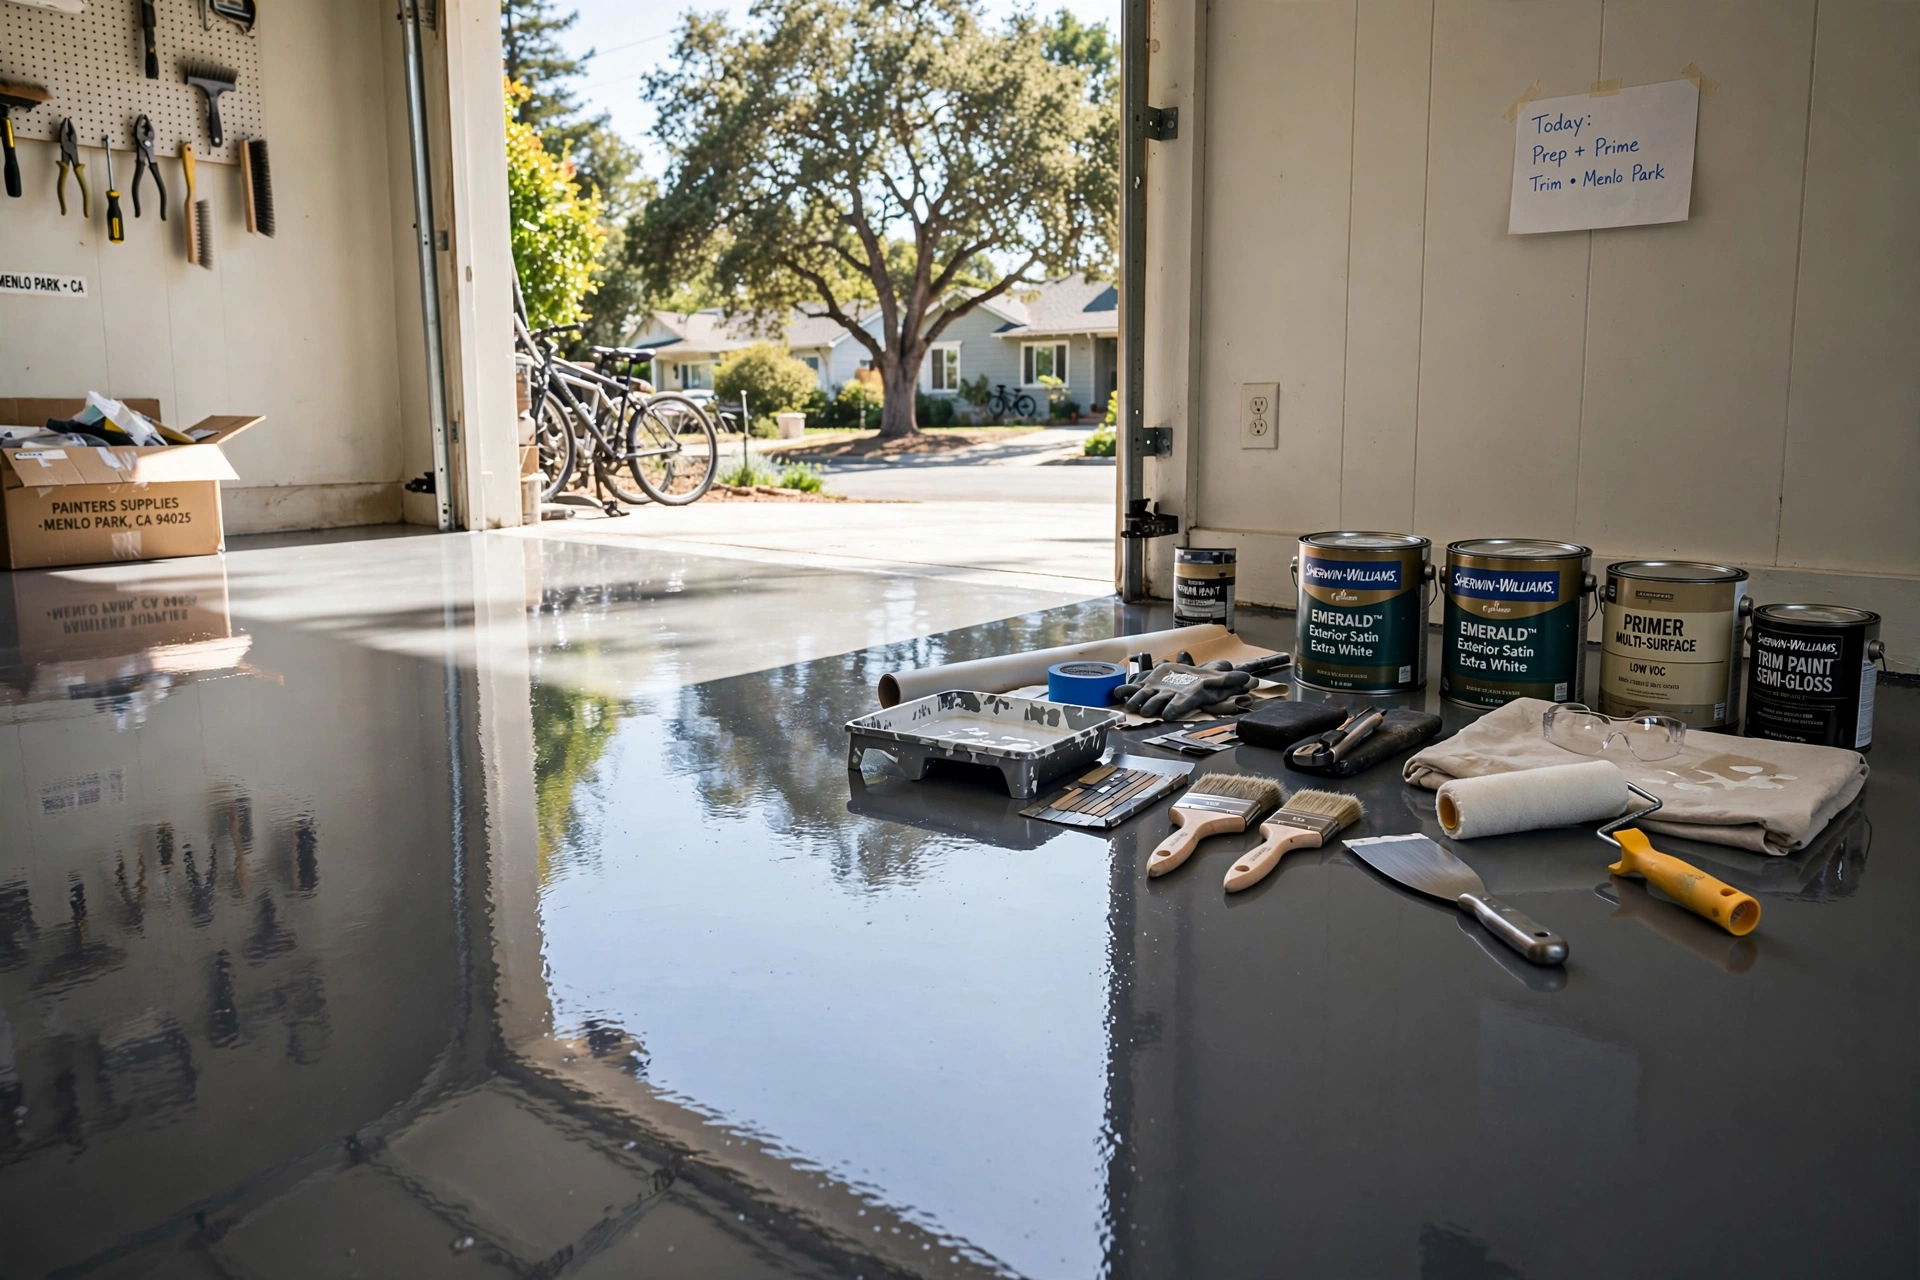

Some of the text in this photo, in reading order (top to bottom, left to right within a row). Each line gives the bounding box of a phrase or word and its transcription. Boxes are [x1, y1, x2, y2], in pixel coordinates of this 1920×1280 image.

[1532, 113, 1592, 137] Today:
[1532, 144, 1567, 168] Prep
[1595, 137, 1640, 157] Prime
[1529, 174, 1562, 192] Trim
[1583, 168, 1624, 187] Menlo
[1631, 163, 1665, 182] Park
[0, 275, 32, 290] MENLO
[34, 277, 61, 292] PARK
[70, 279, 84, 293] CA
[52, 497, 179, 514] PAINTERS SUPPLIES
[95, 515, 133, 529] PARK,
[136, 514, 152, 526] CA
[156, 512, 191, 525] 94025
[1309, 624, 1379, 643] Exterior Satin
[1623, 613, 1684, 637] PRIMER
[1311, 640, 1373, 657] Extra White
[1457, 637, 1534, 657] Exterior Satin
[1615, 631, 1697, 652] MULTI-SURFACE
[1460, 653, 1528, 673] Extra White
[1629, 662, 1666, 677] LOW VOC
[1757, 649, 1835, 676] TRIM PAINT
[1756, 667, 1833, 693] SEMI-GLOSS
